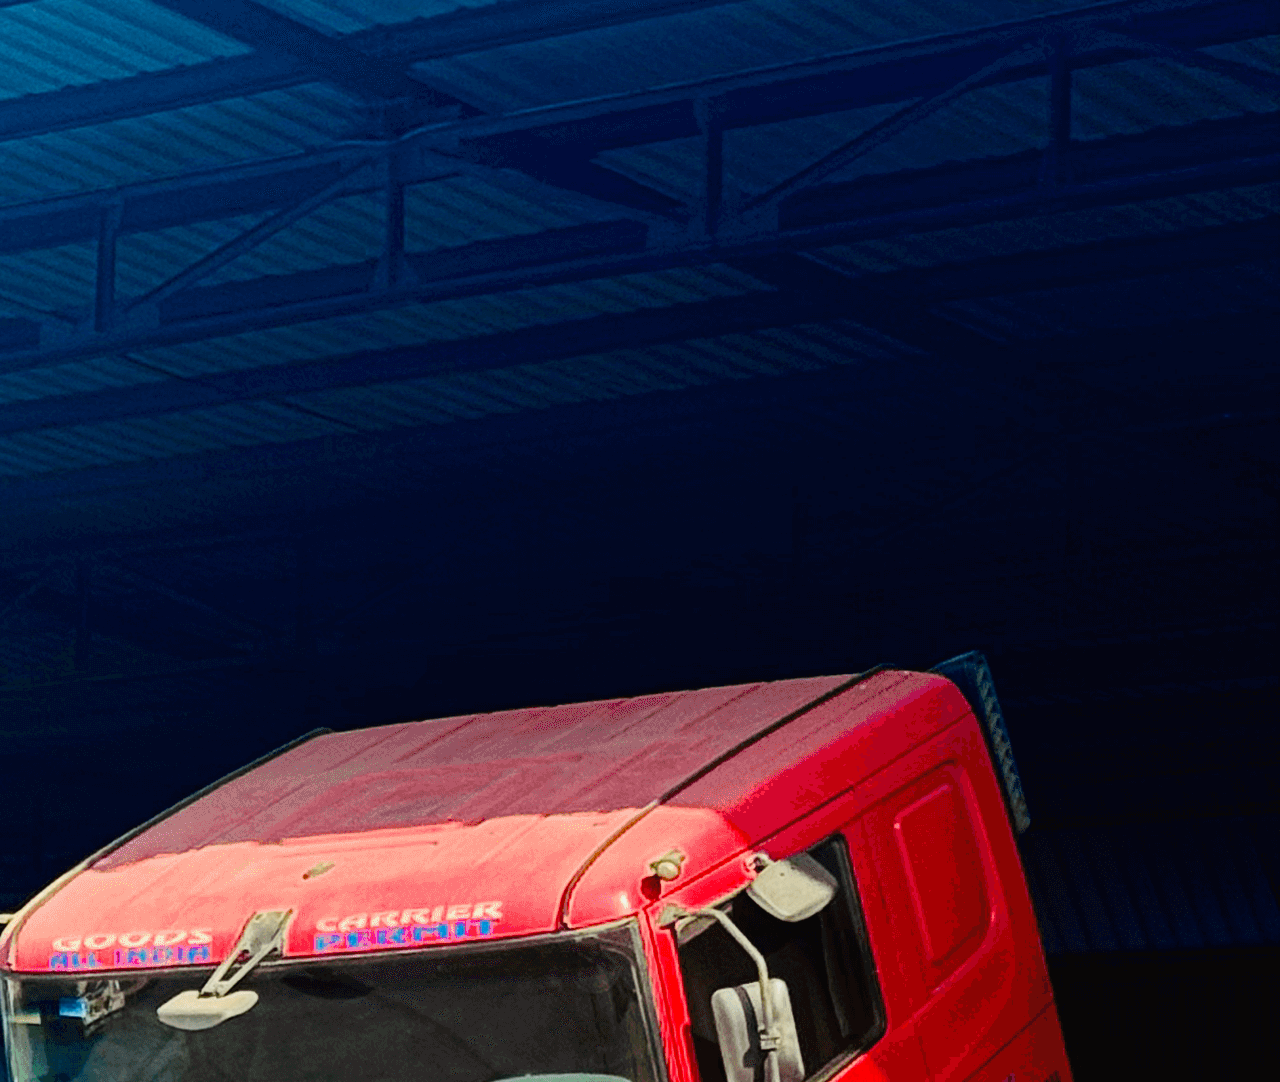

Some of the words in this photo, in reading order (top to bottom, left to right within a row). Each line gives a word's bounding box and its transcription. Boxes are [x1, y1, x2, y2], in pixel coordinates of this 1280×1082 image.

[49, 951, 100, 969] ALL
[113, 945, 211, 966] INDIA
[316, 919, 499, 951] PERMIT
[53, 928, 213, 951] GOODS
[316, 902, 502, 932] CARRIER
